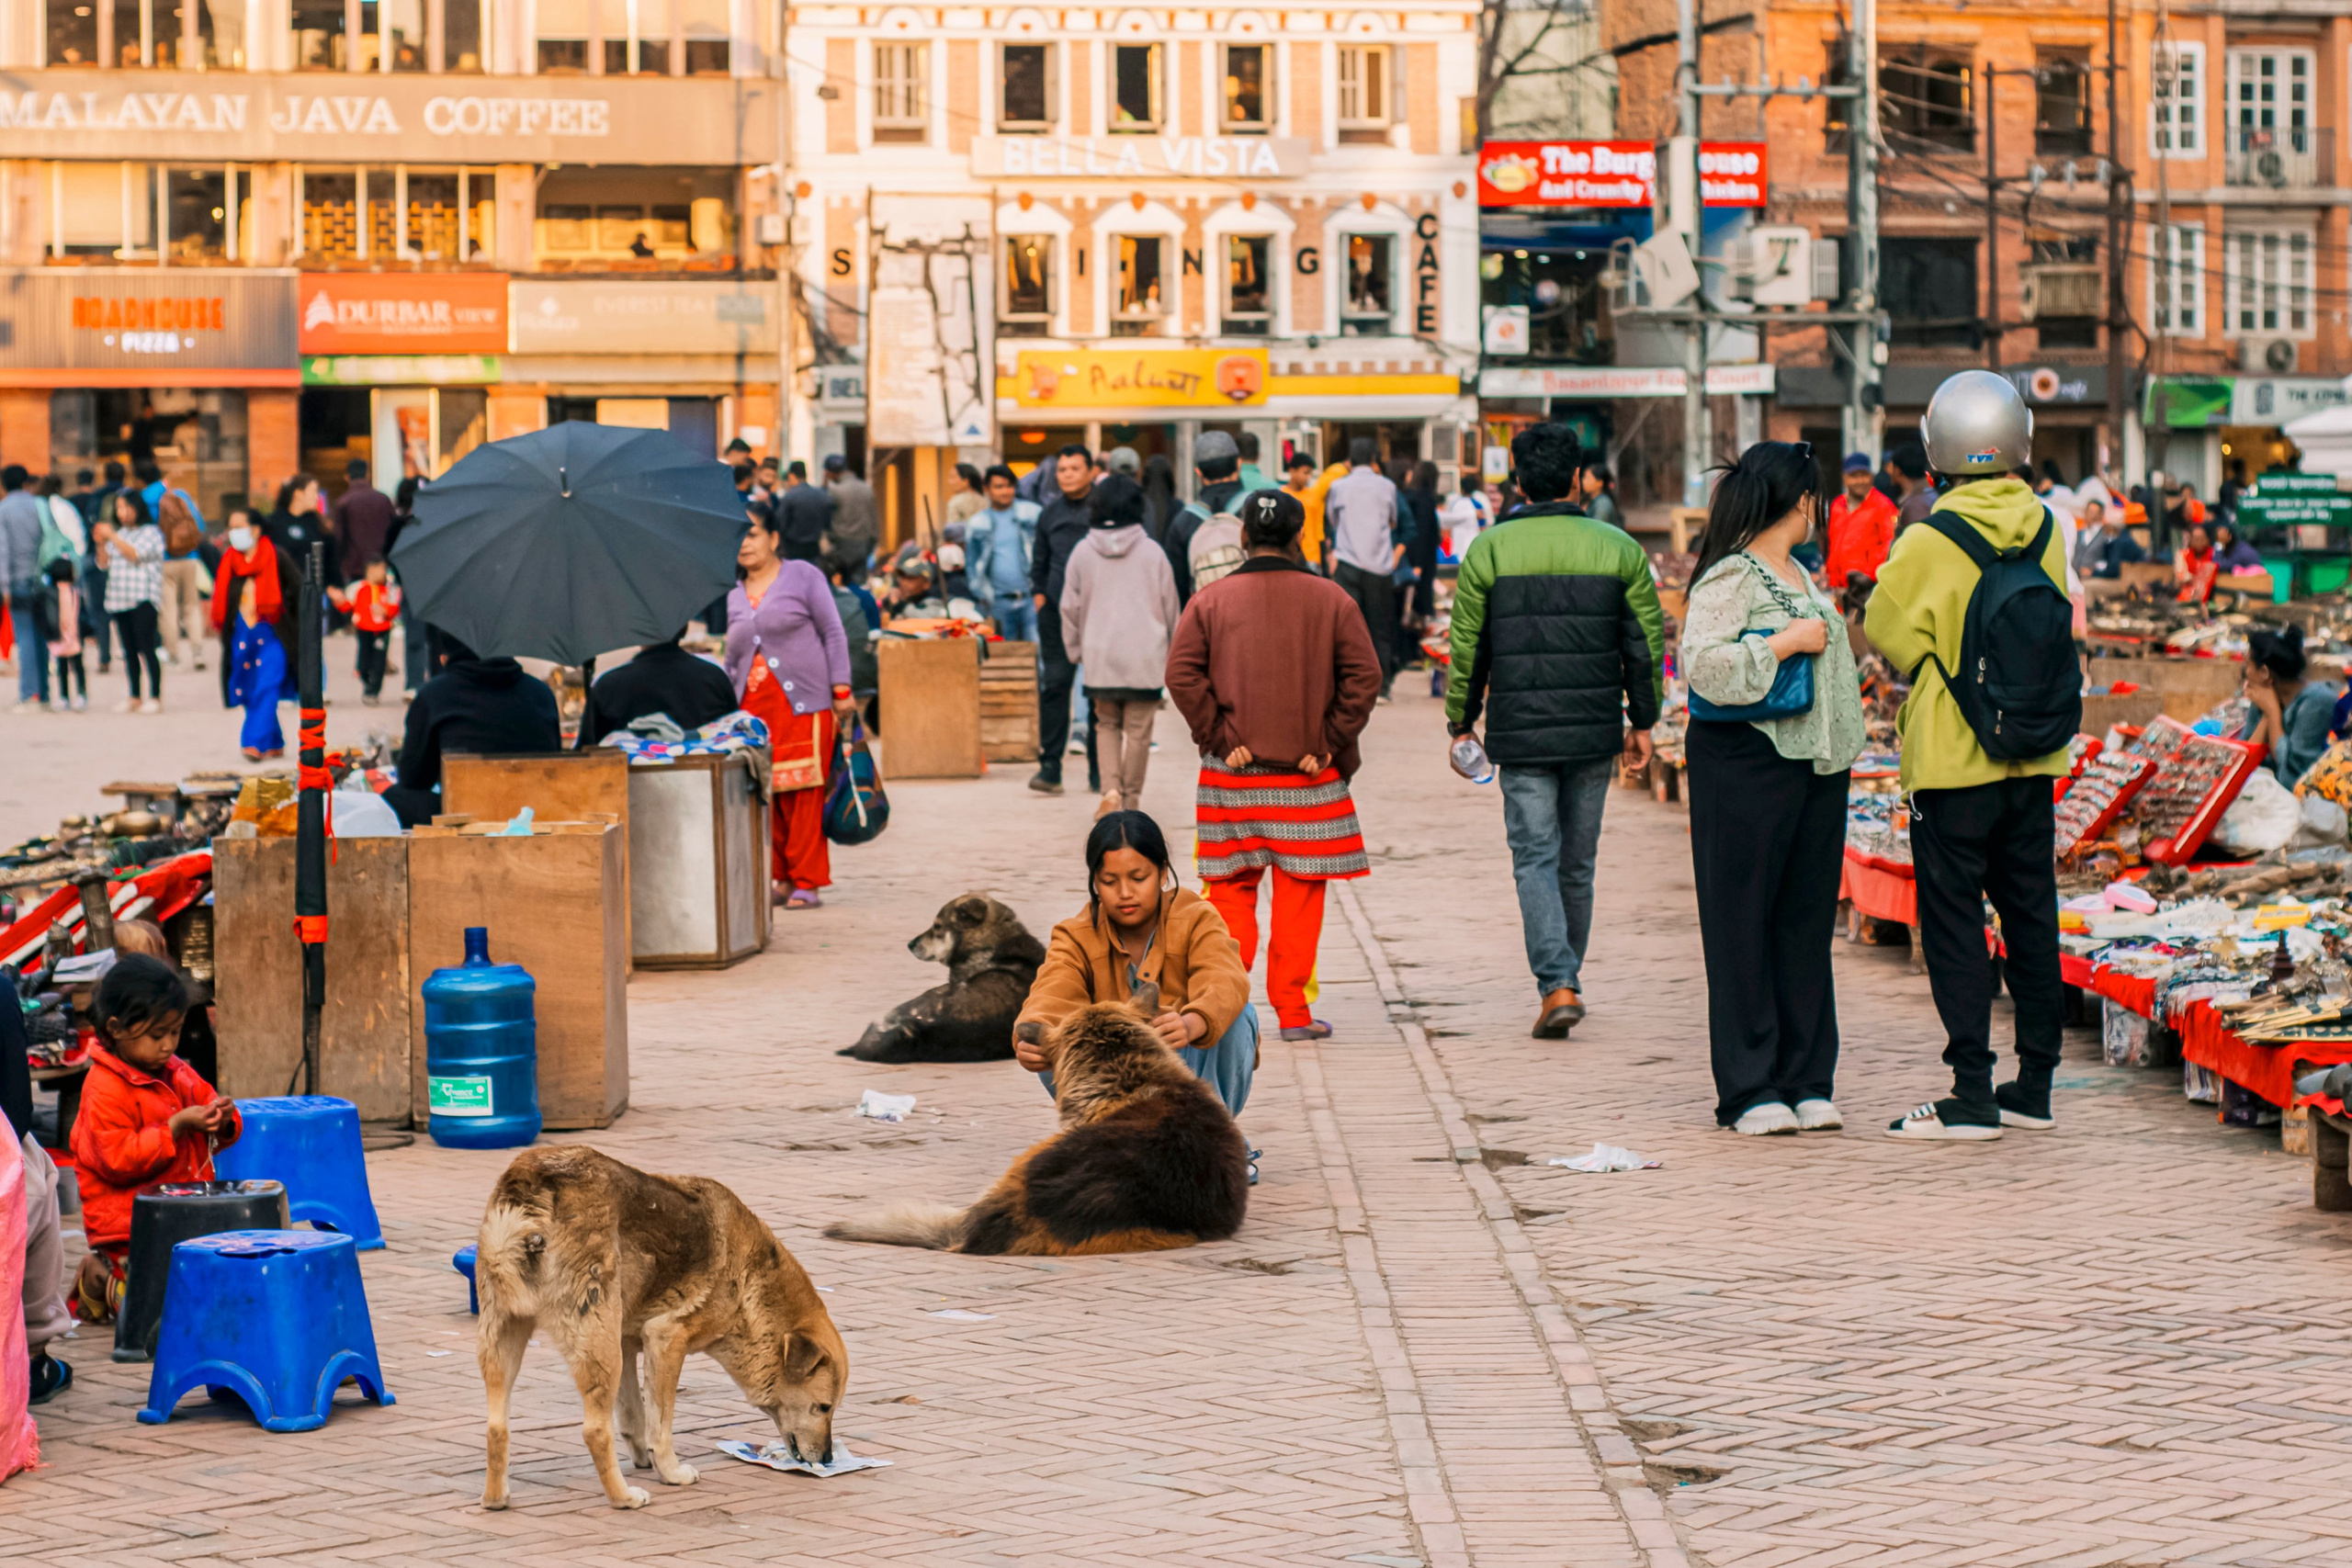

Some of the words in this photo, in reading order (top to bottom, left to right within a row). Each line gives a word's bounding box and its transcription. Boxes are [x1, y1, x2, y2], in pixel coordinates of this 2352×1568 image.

[0, 91, 248, 130] MALAYAN
[270, 95, 401, 133] JAVA
[424, 96, 610, 136] COFFEE
[1002, 138, 1143, 175] BELLA
[1160, 139, 1281, 175] VISTA
[1540, 145, 1591, 175] The
[1591, 146, 1655, 182] Burg
[1698, 152, 1759, 175] ouse
[1539, 179, 1574, 199] And
[1575, 178, 1645, 204] Crunchy
[1700, 178, 1759, 200] hicken
[1416, 213, 1439, 333] CAFE
[73, 297, 224, 330] ROADHOUSE
[337, 299, 451, 325] DURBAR
[121, 332, 180, 354] PIZZA
[1657, 368, 1689, 388] Foo
[1967, 454, 1995, 463] TVS
